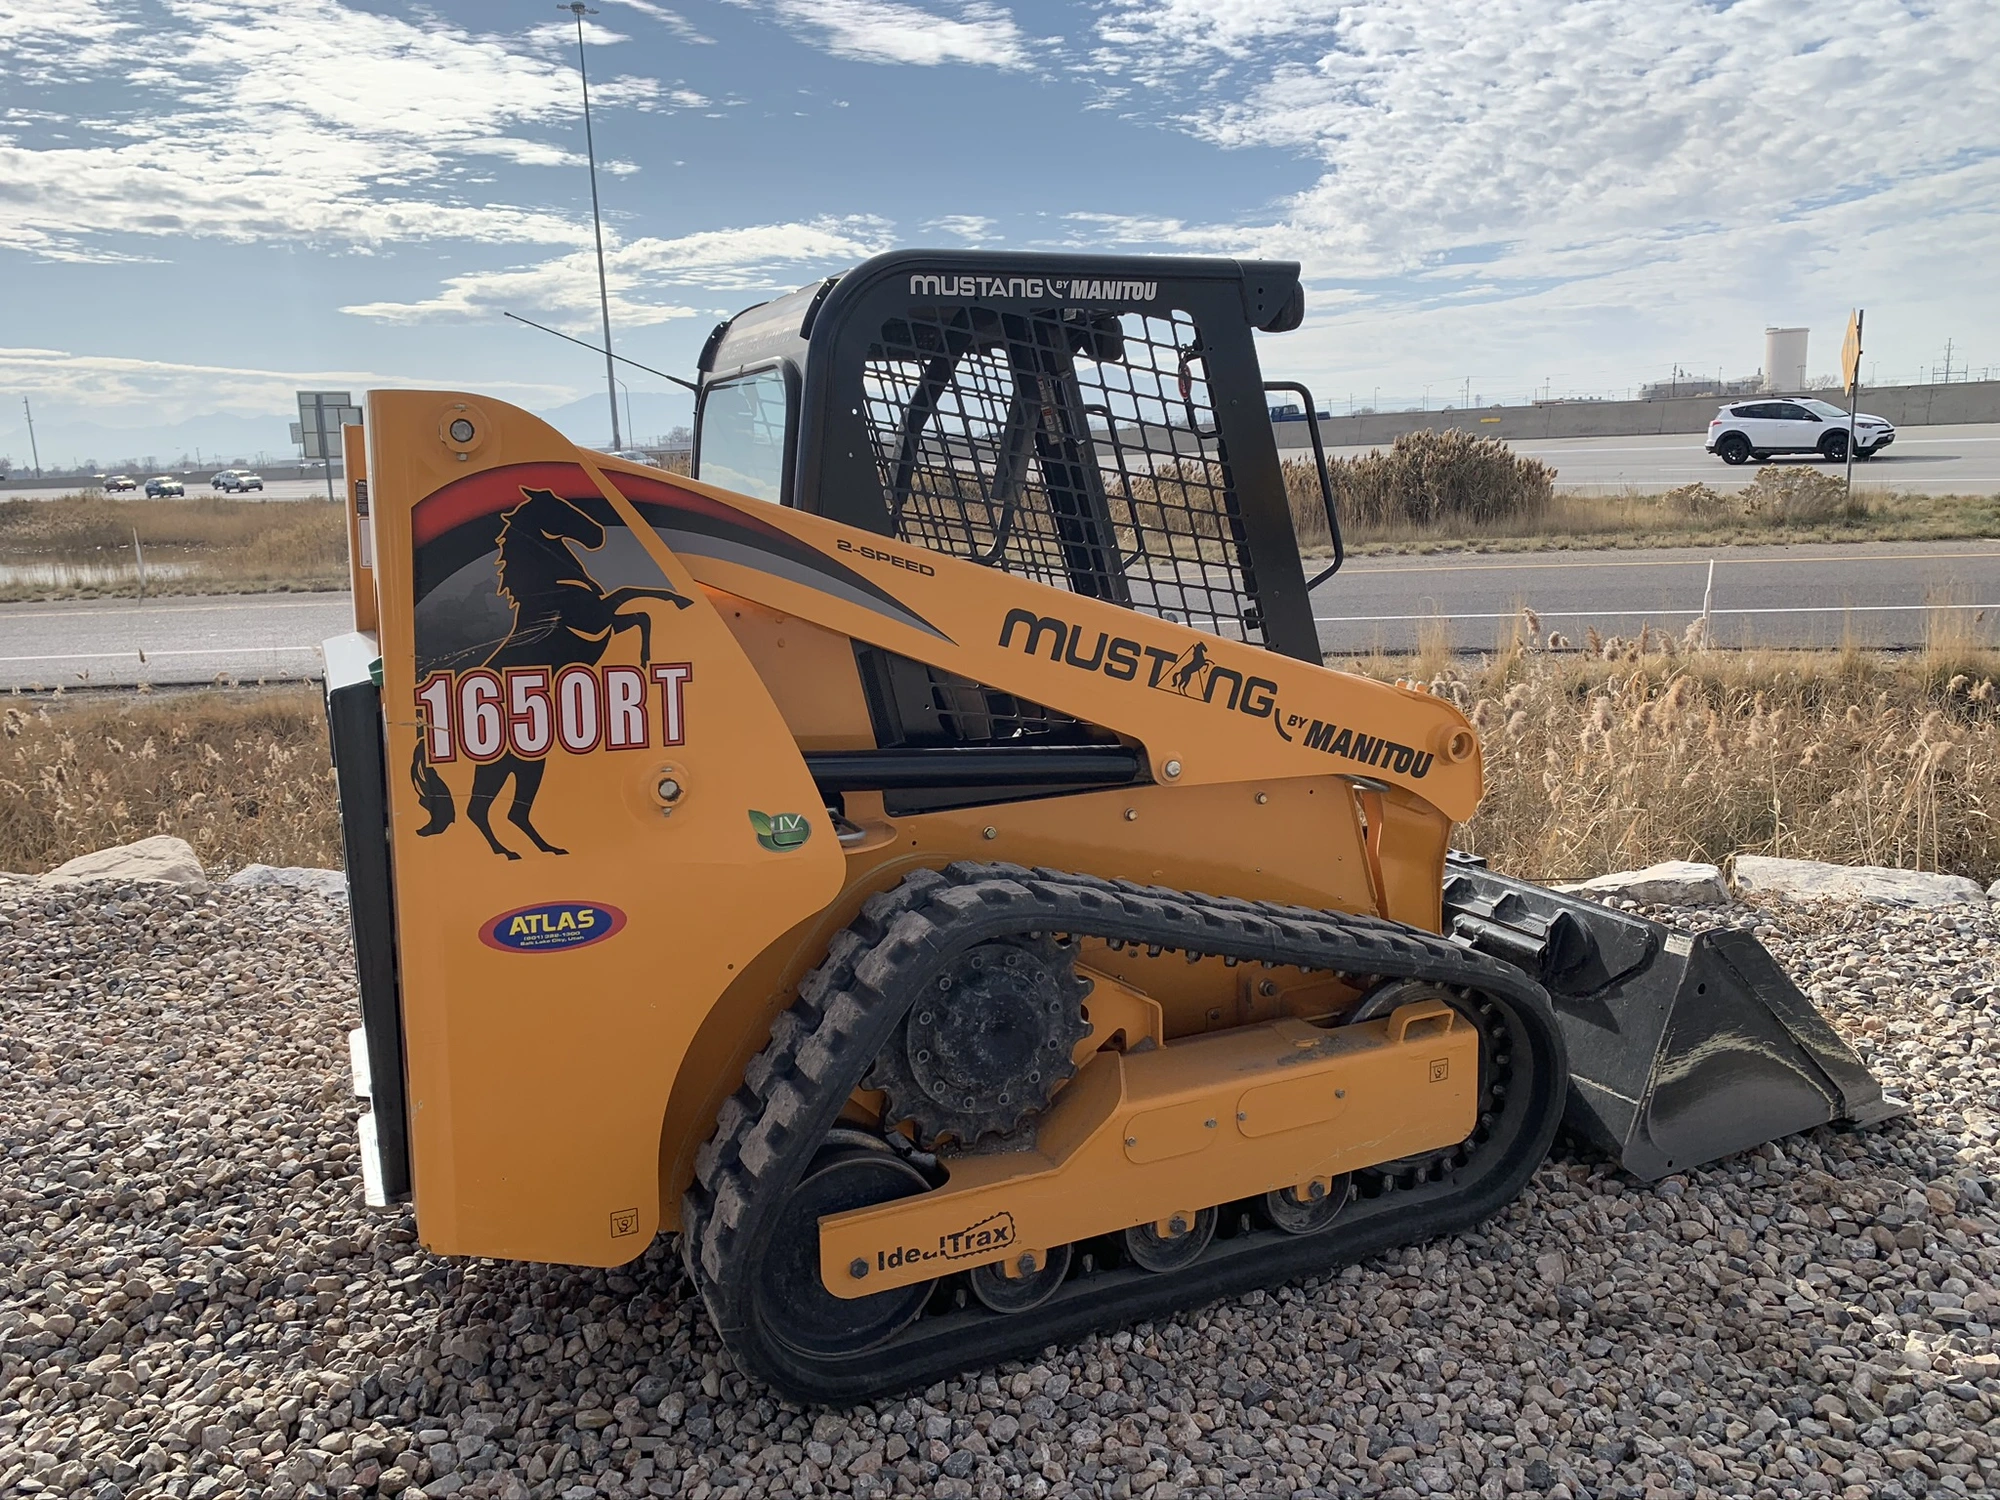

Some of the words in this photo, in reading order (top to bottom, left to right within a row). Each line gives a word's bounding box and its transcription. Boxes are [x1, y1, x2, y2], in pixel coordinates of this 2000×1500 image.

[910, 275, 1043, 298] MUSTANG
[1056, 280, 1069, 289] BY
[1070, 279, 1158, 301] MANITOU
[836, 539, 935, 577] 2-SPEED
[414, 662, 693, 764] 1650RT
[1287, 714, 1309, 729] BY
[1303, 719, 1434, 779] MANITOU
[509, 909, 595, 936] ATLAS
